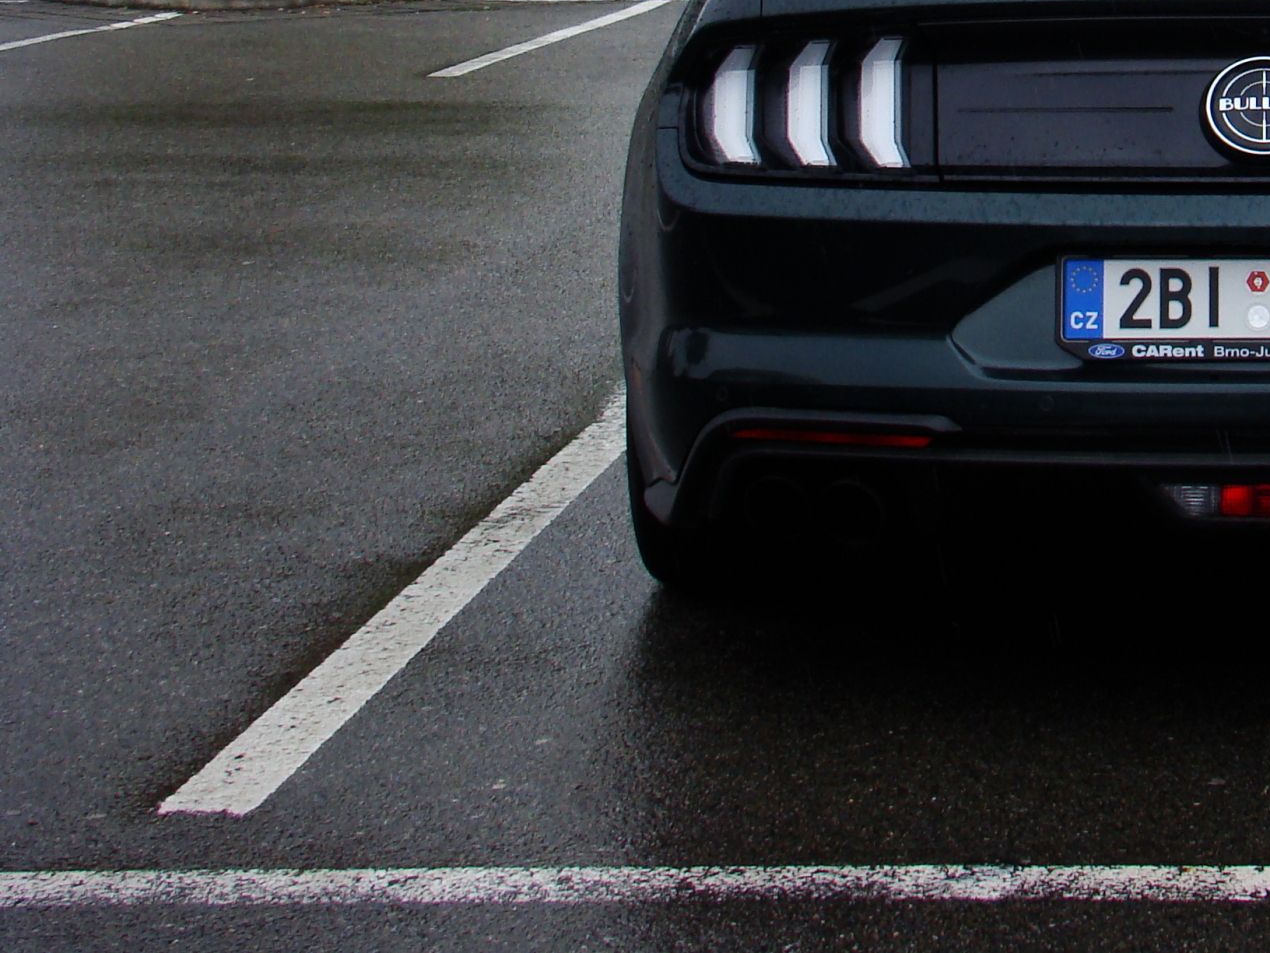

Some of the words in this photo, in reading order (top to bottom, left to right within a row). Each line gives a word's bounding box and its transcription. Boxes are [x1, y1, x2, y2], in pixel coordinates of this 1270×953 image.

[1118, 266, 1220, 330] 2BI
[1070, 312, 1099, 330] CZ
[1131, 345, 1205, 358] CARent
